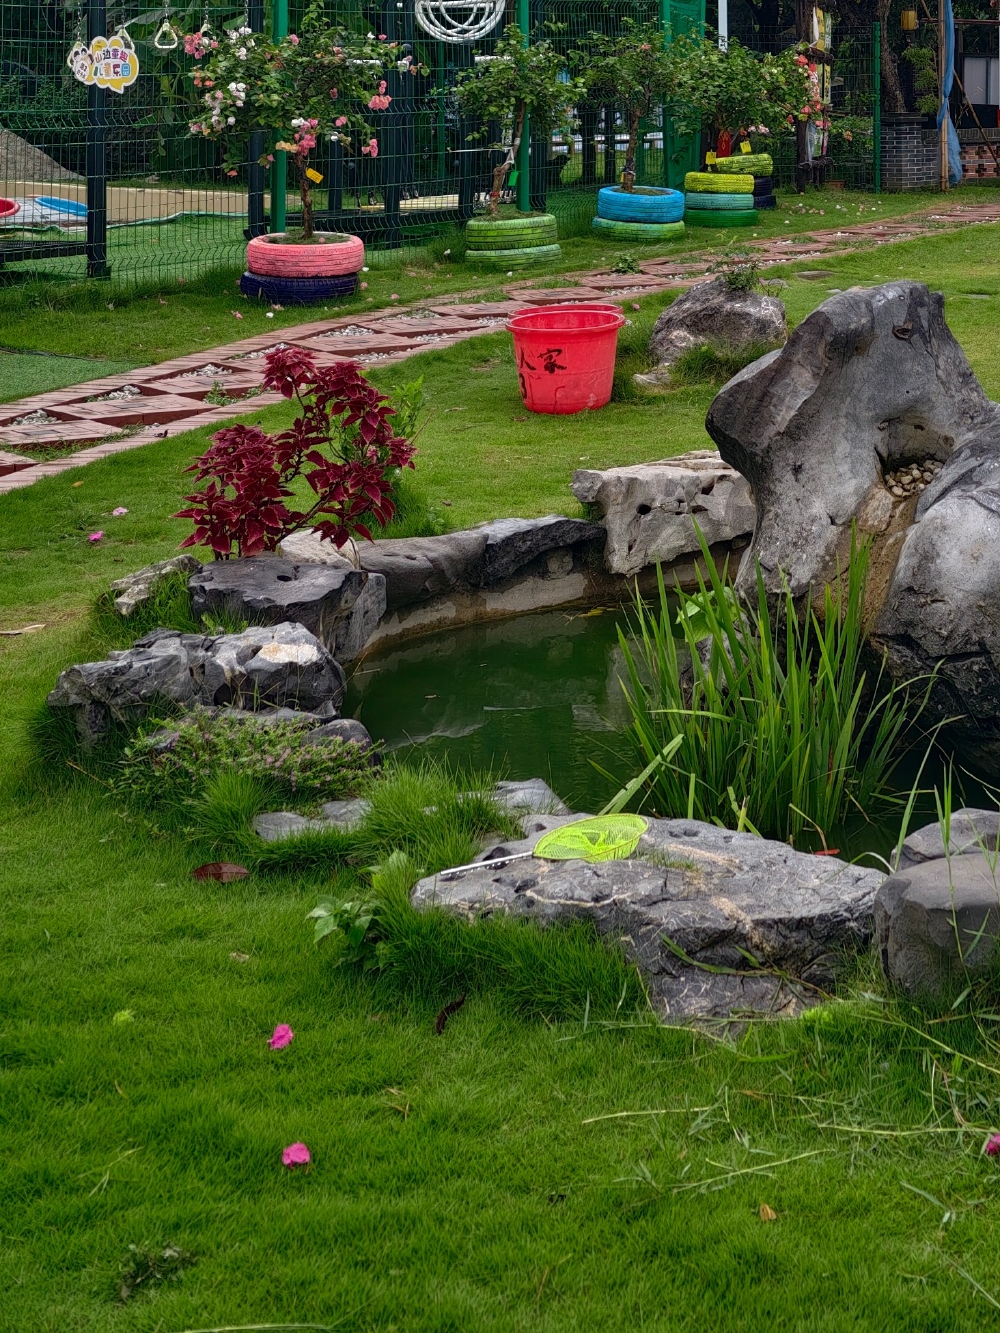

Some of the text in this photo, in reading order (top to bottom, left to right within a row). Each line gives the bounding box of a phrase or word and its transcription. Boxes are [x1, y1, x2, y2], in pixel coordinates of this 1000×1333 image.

[95, 48, 129, 63] 山边童趣
[93, 62, 131, 77] 儿童乐园
